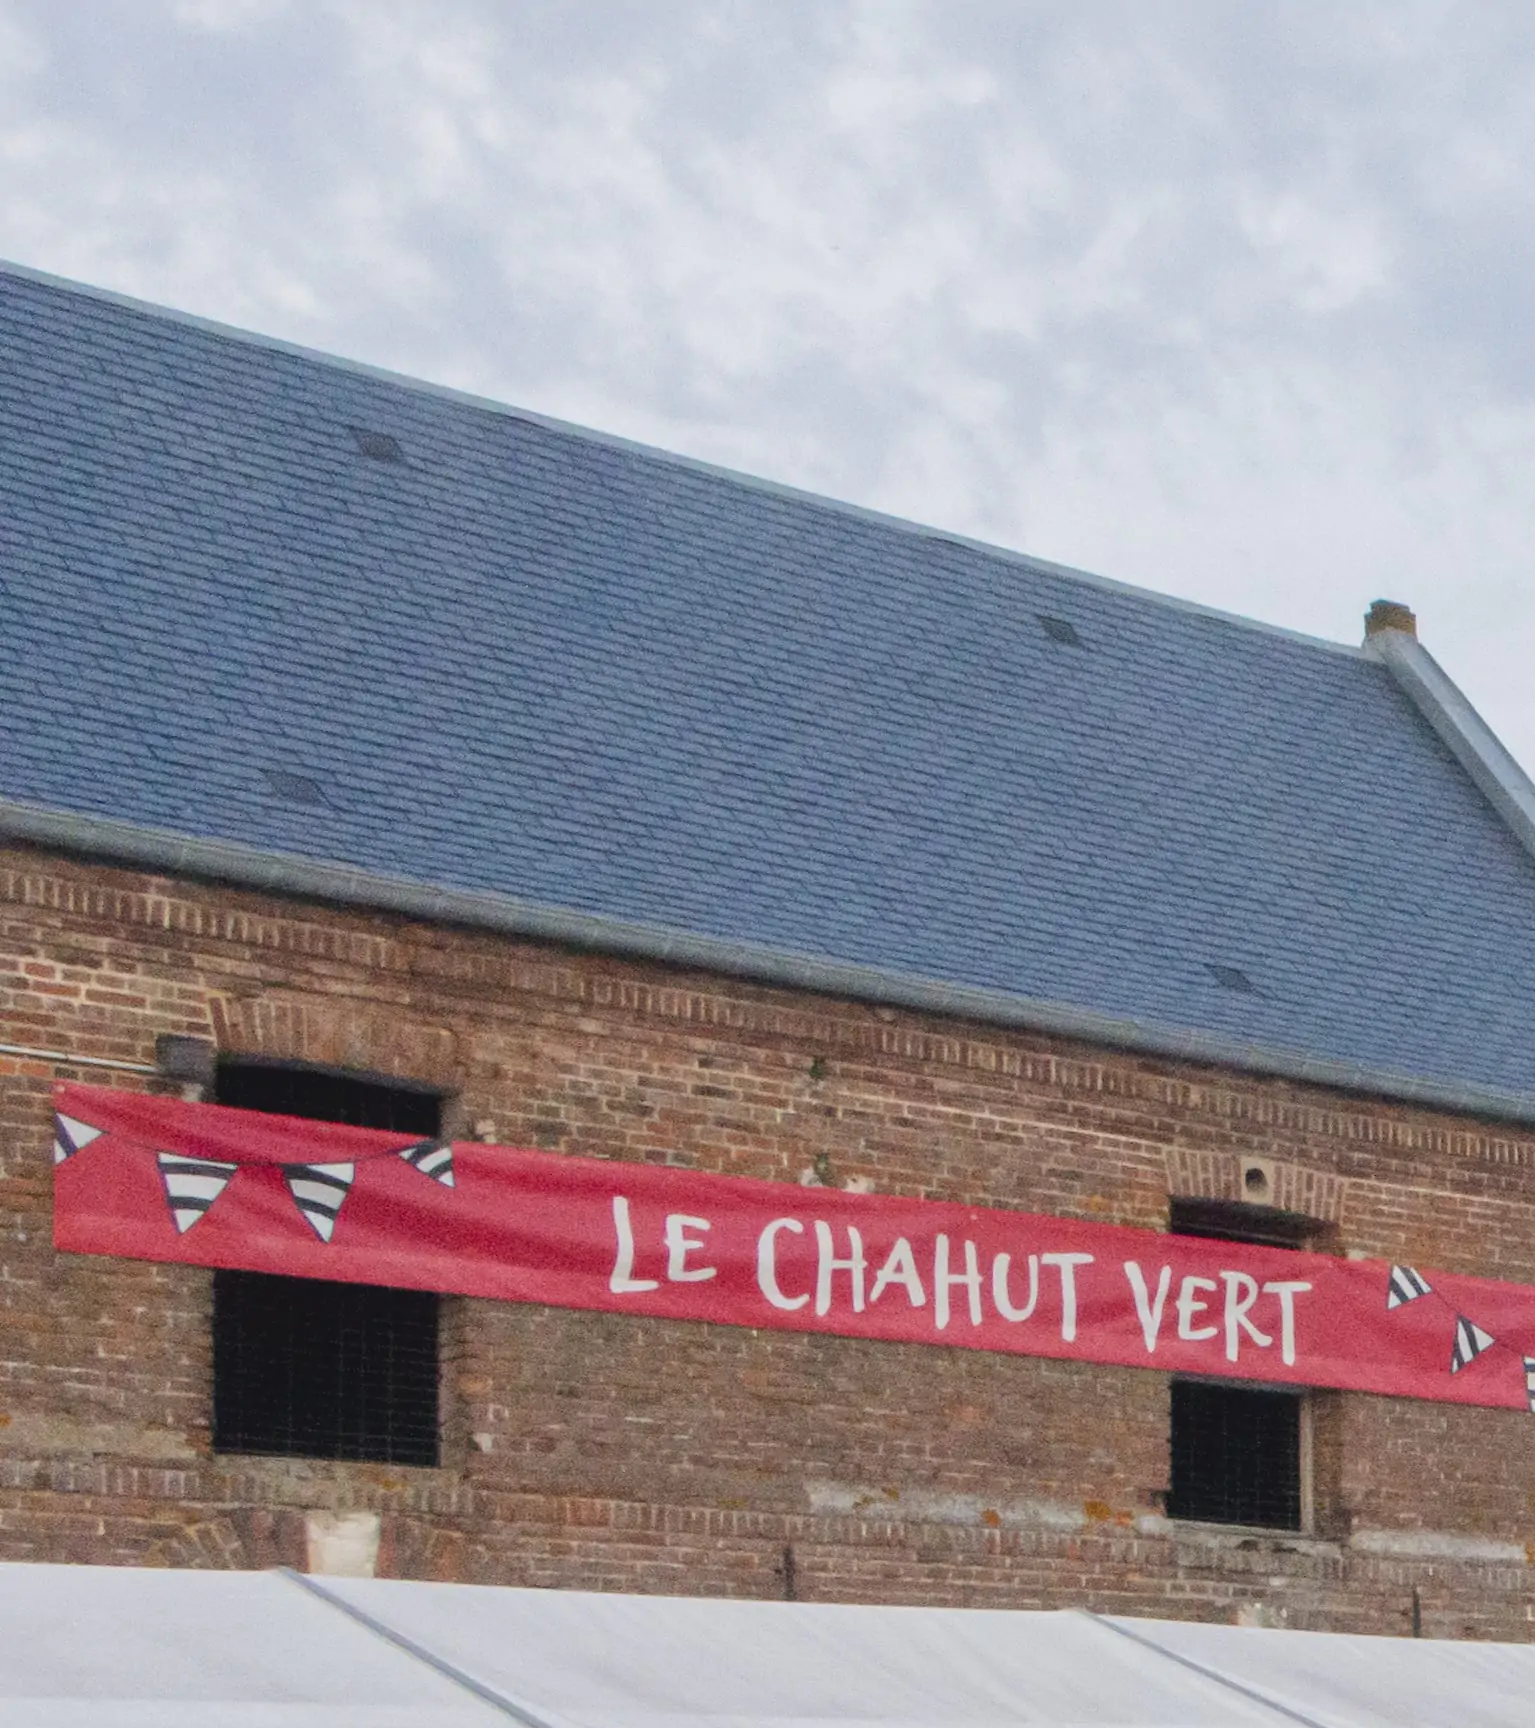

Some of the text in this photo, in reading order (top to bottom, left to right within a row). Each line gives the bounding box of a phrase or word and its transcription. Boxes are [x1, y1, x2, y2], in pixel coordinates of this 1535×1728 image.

[610, 1196, 1312, 1367] LE CHAHUT VERT
